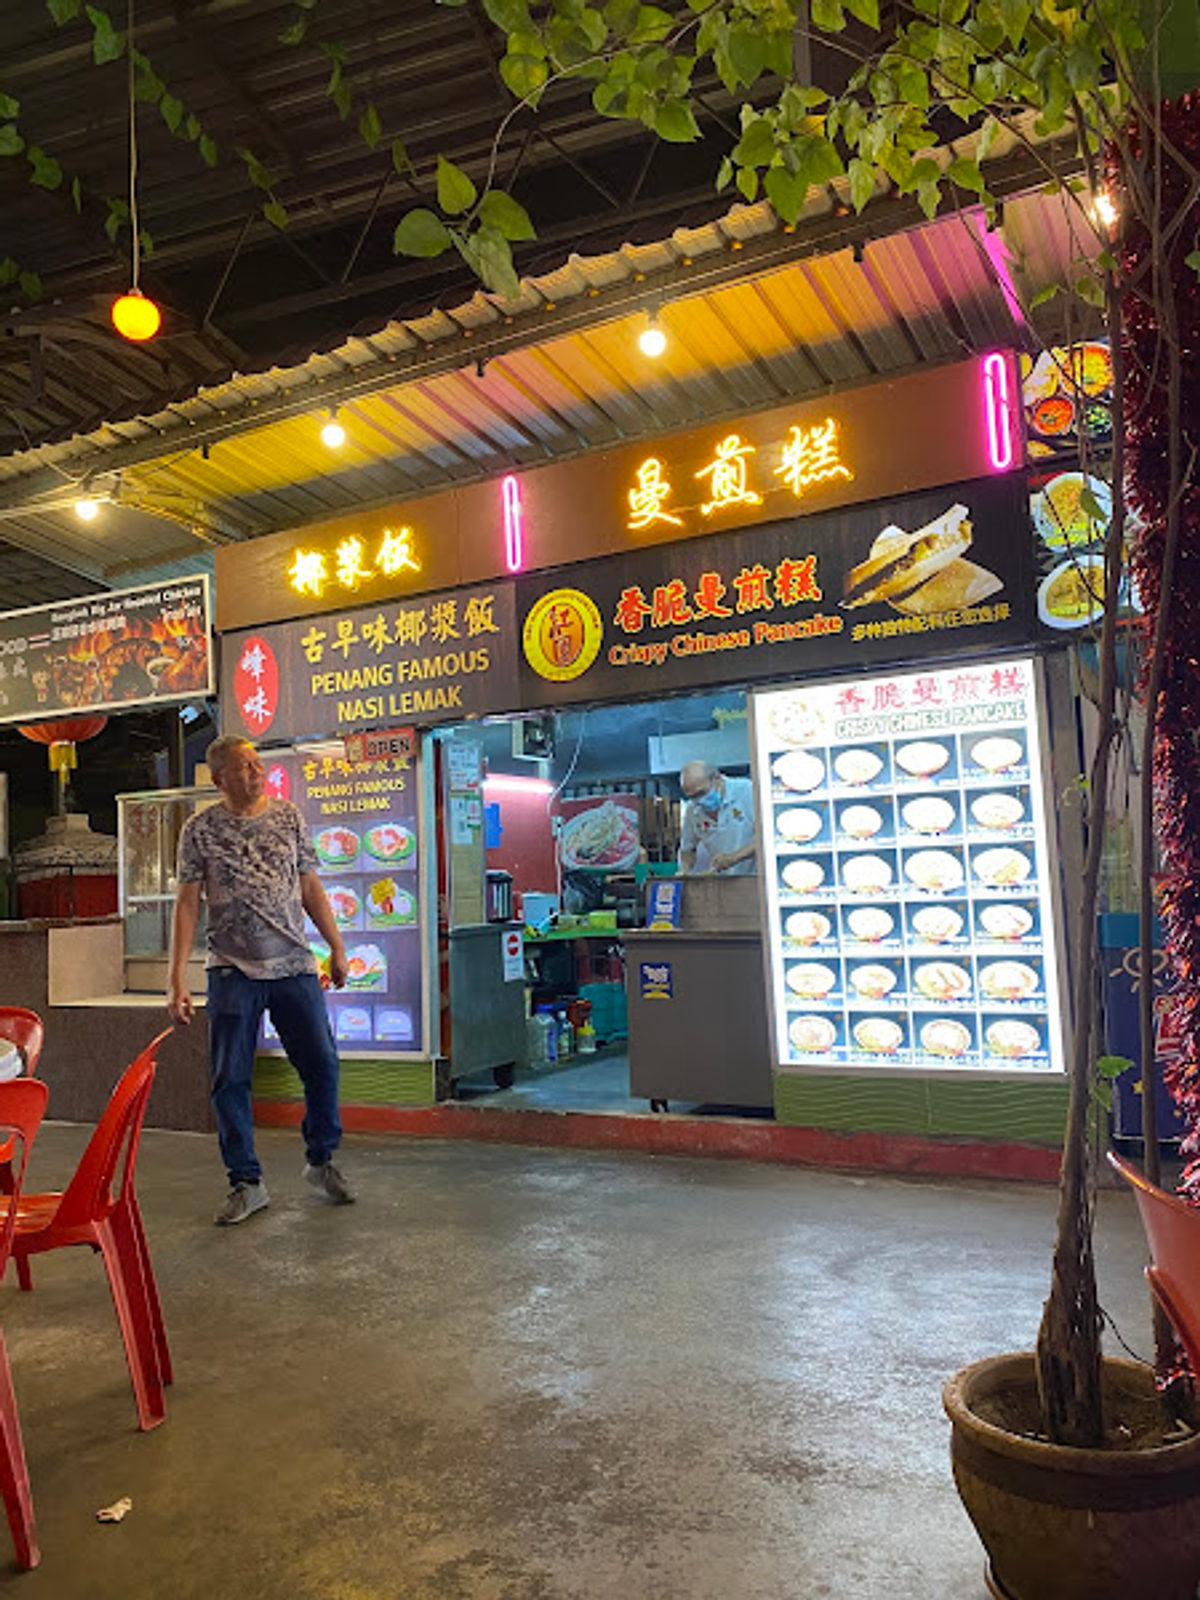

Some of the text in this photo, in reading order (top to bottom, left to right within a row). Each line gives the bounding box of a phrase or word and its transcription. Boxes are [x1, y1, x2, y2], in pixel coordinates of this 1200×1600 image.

[627, 418, 853, 528] 曼煎糕
[613, 555, 822, 632] 香脆曼煎糕
[608, 613, 844, 666] Crispy Chinese Pancake
[311, 649, 490, 695] PENANG FAMOUS
[835, 665, 1026, 714] 香脆曼煎糕
[337, 686, 463, 722] NASI LEMAK
[835, 699, 1028, 740] CRISPY CHINESE PANCAKE
[367, 738, 410, 757] OPEN
[306, 777, 406, 799] PENANG FAMOUS
[320, 797, 391, 815] NASI LEMAK
